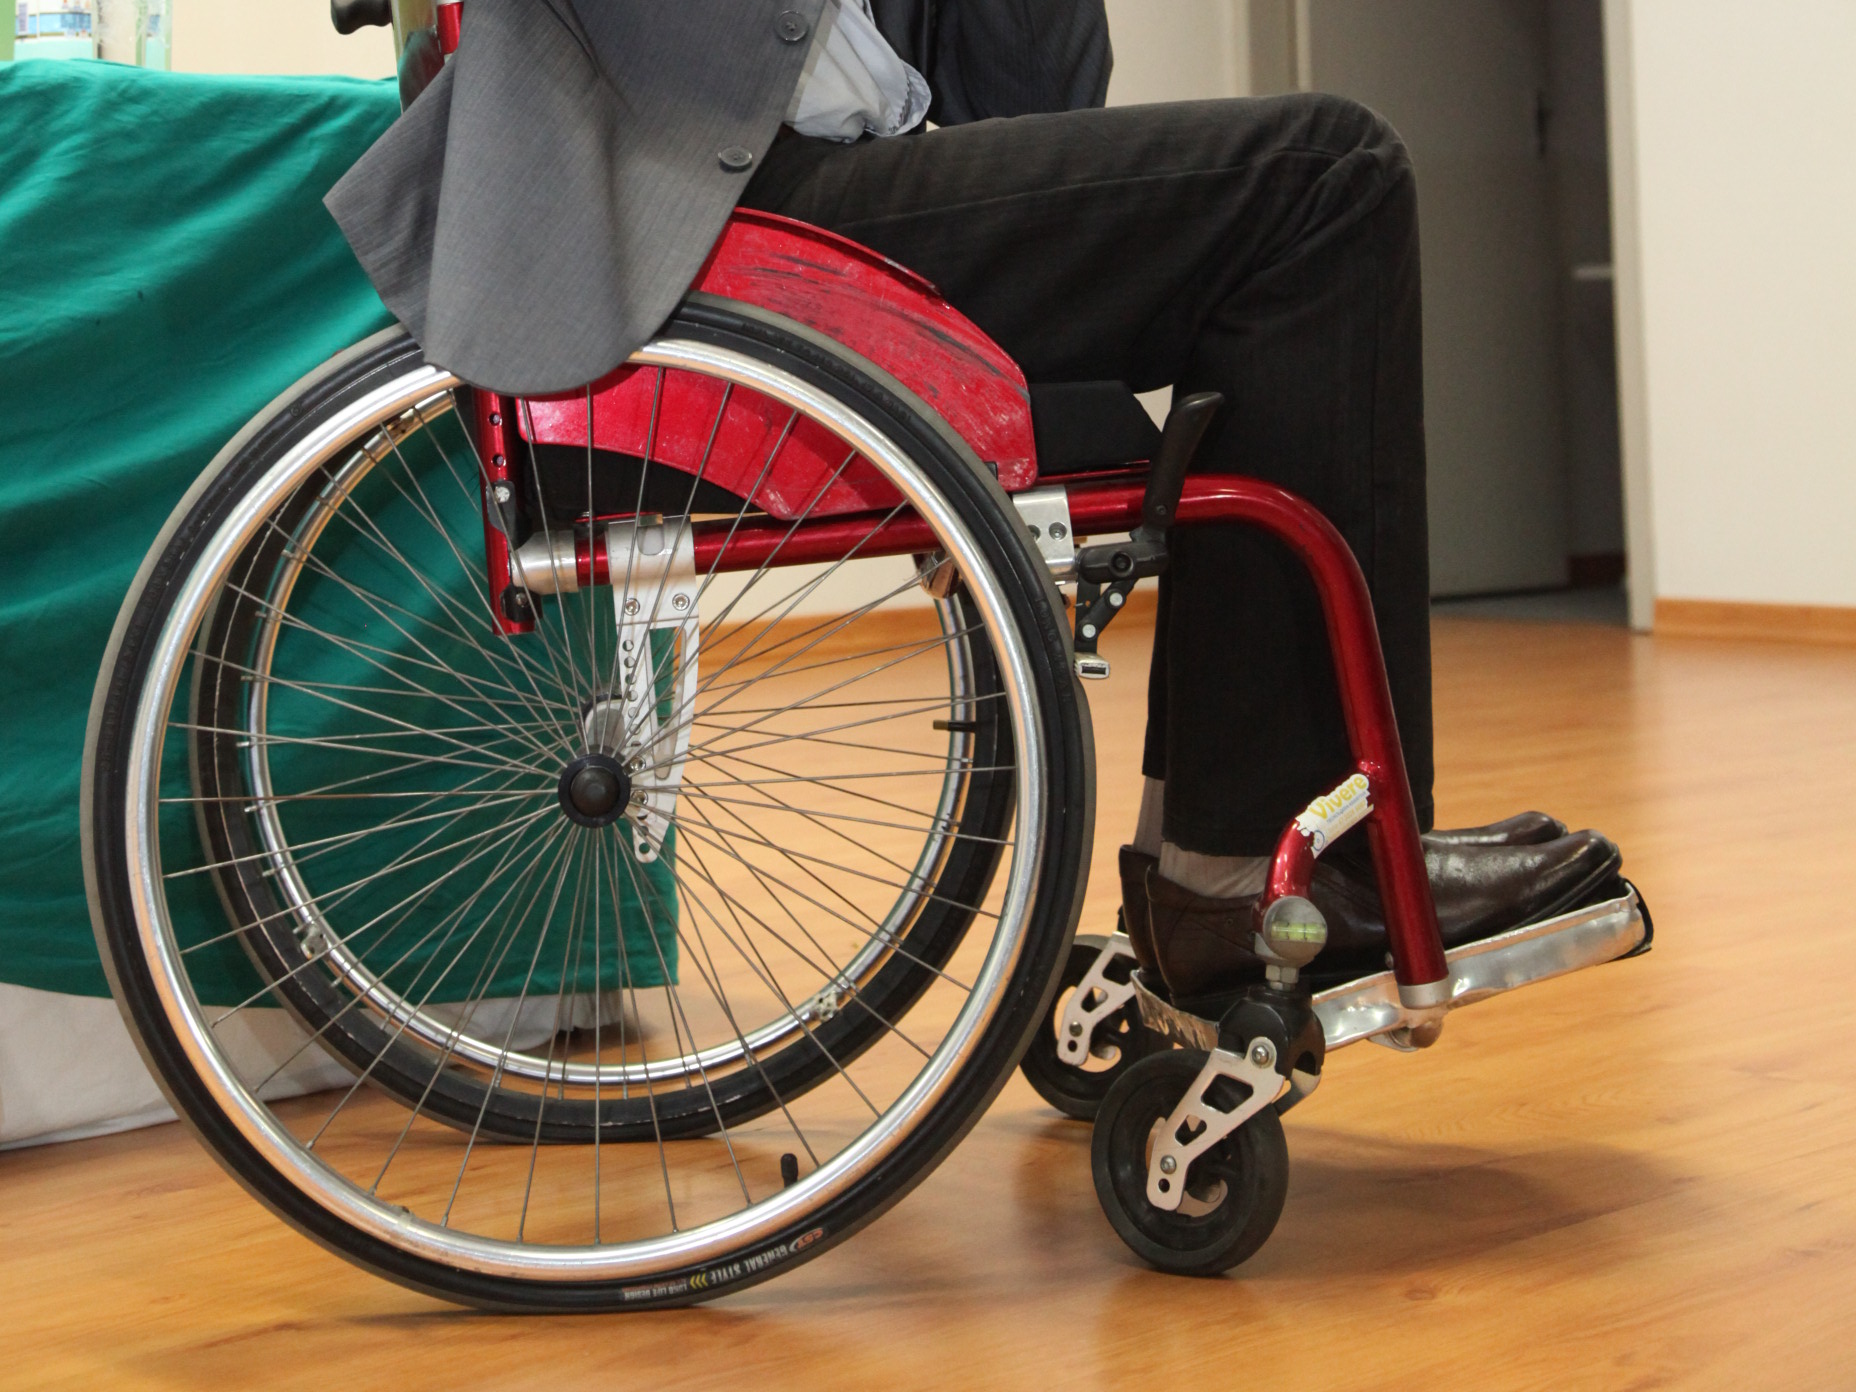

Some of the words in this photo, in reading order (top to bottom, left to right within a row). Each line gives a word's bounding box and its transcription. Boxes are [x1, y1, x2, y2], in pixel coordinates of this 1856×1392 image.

[1309, 776, 1367, 820] Vivere
[711, 1261, 741, 1285] STYLE
[746, 1243, 790, 1273] GENERAL
